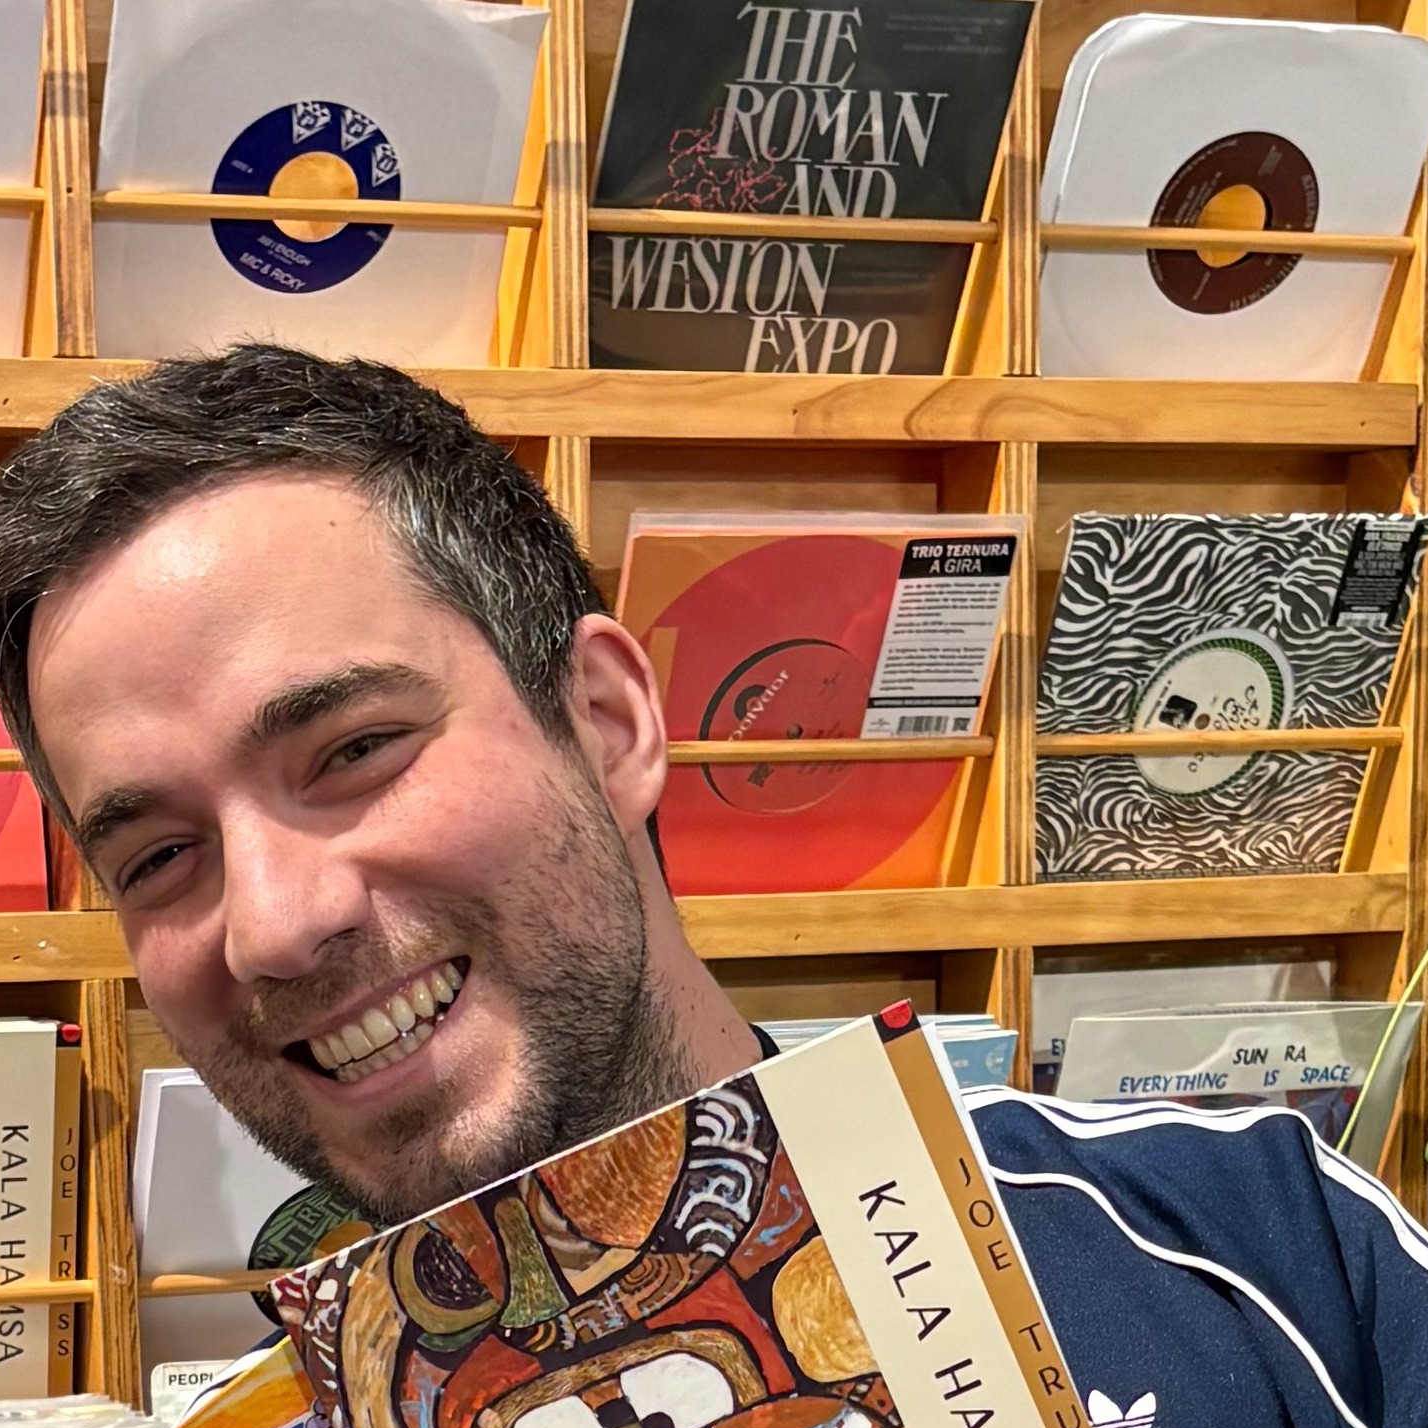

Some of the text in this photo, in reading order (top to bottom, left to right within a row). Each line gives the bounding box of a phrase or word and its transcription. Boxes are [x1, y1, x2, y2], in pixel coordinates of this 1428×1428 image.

[737, 2, 862, 87] THE
[710, 83, 948, 168] ROMAN
[779, 164, 897, 218] AND
[606, 236, 844, 316] WESTON
[745, 312, 898, 374] EXPO
[912, 544, 1009, 558] TRIO TERNURA
[929, 559, 982, 574] A GIRA
[1119, 1065, 1351, 1094] EVERYTHING IS SPACE
[1233, 1045, 1306, 1066] SUN RA
[1, 1124, 29, 1221] KALA
[56, 1127, 77, 1356] JOE TRSS
[958, 1157, 1012, 1272] JOE
[859, 1180, 952, 1341] KALA
